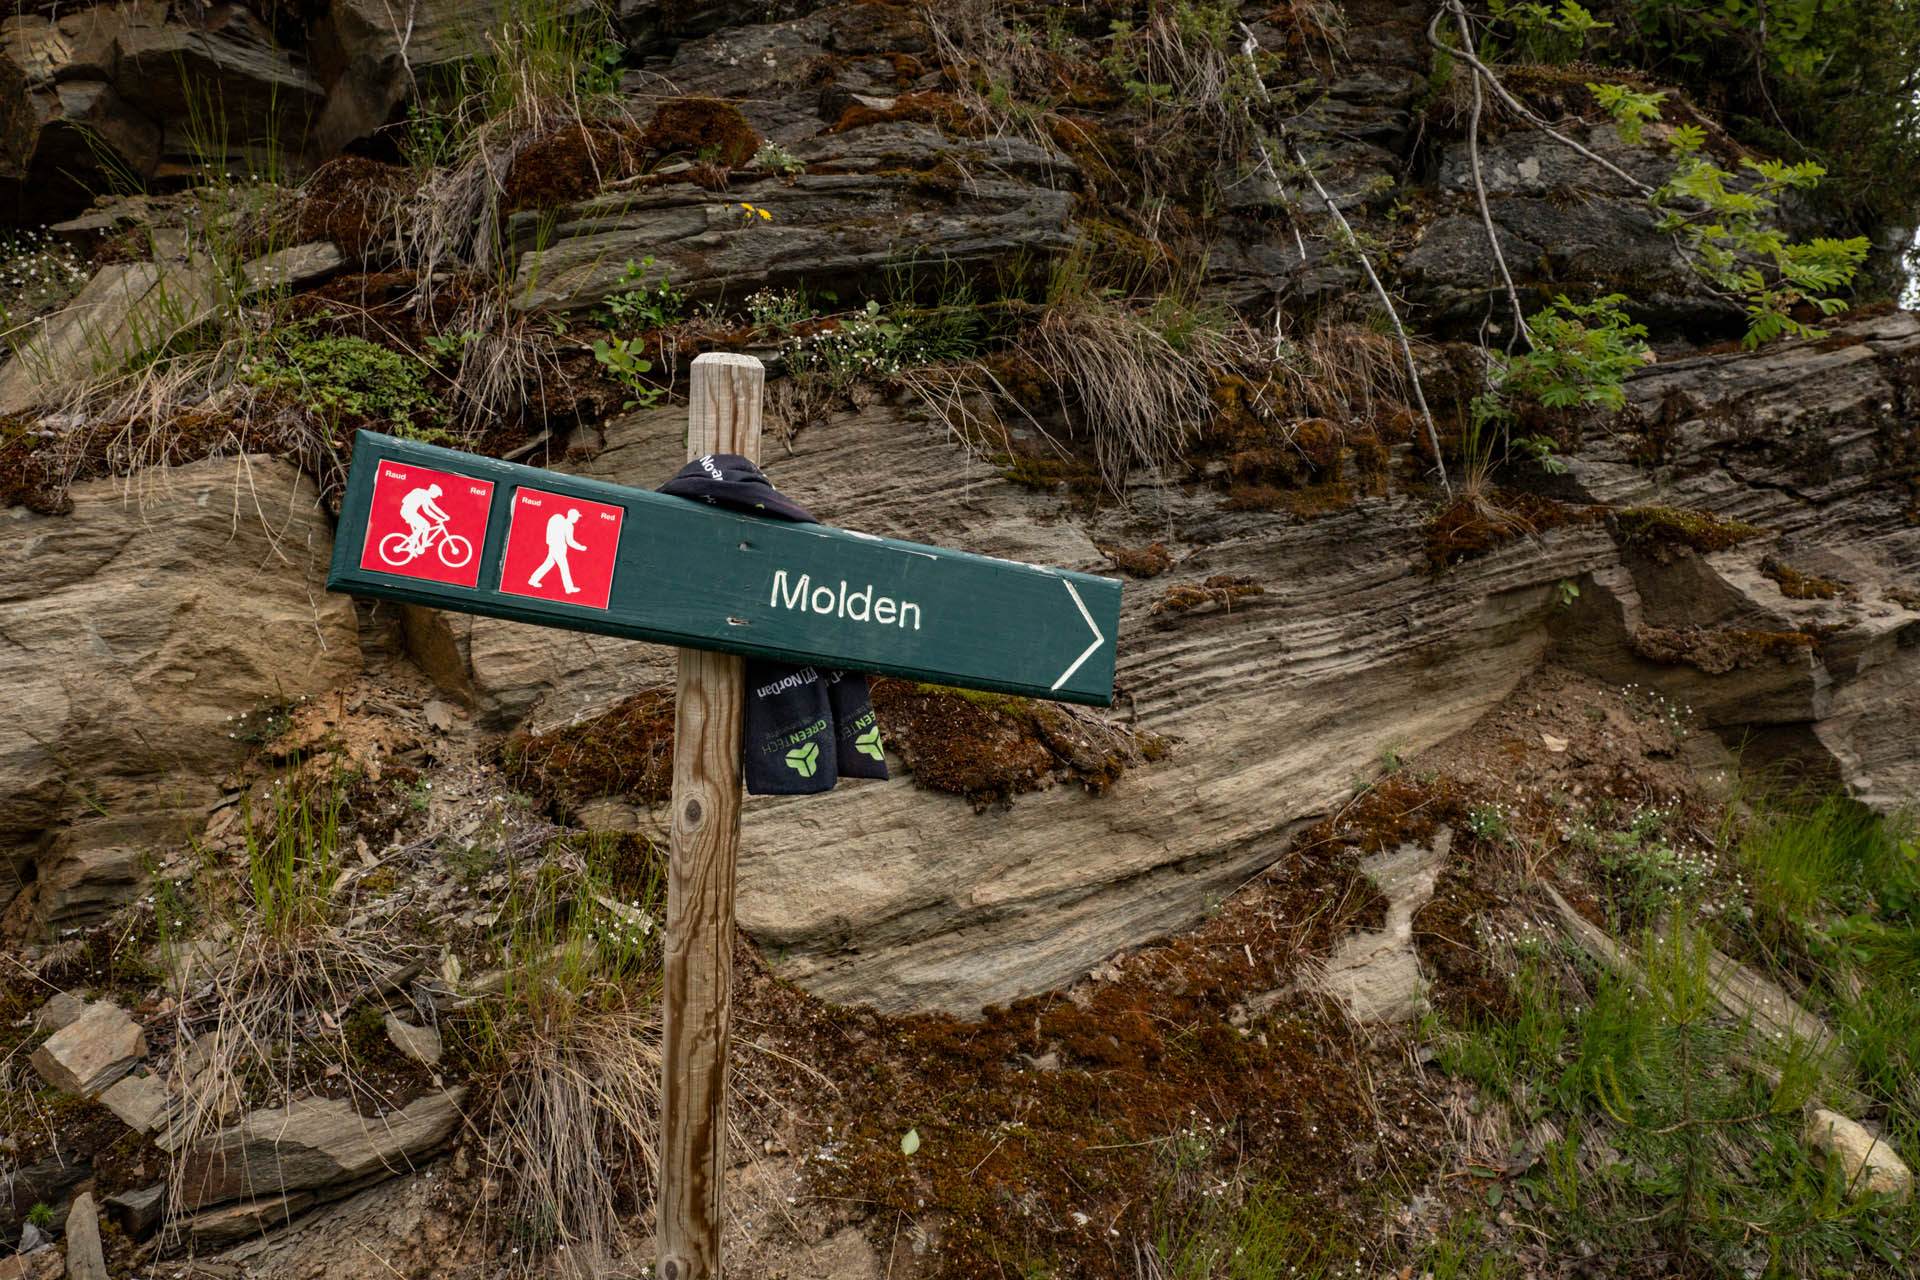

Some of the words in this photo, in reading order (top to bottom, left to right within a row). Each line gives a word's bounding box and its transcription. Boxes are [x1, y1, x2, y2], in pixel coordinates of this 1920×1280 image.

[385, 470, 406, 481] Raud
[470, 486, 486, 497] Red
[521, 496, 542, 507] Raud
[600, 511, 616, 521] Red
[770, 570, 921, 631] Molden
[757, 672, 803, 698] NorDan
